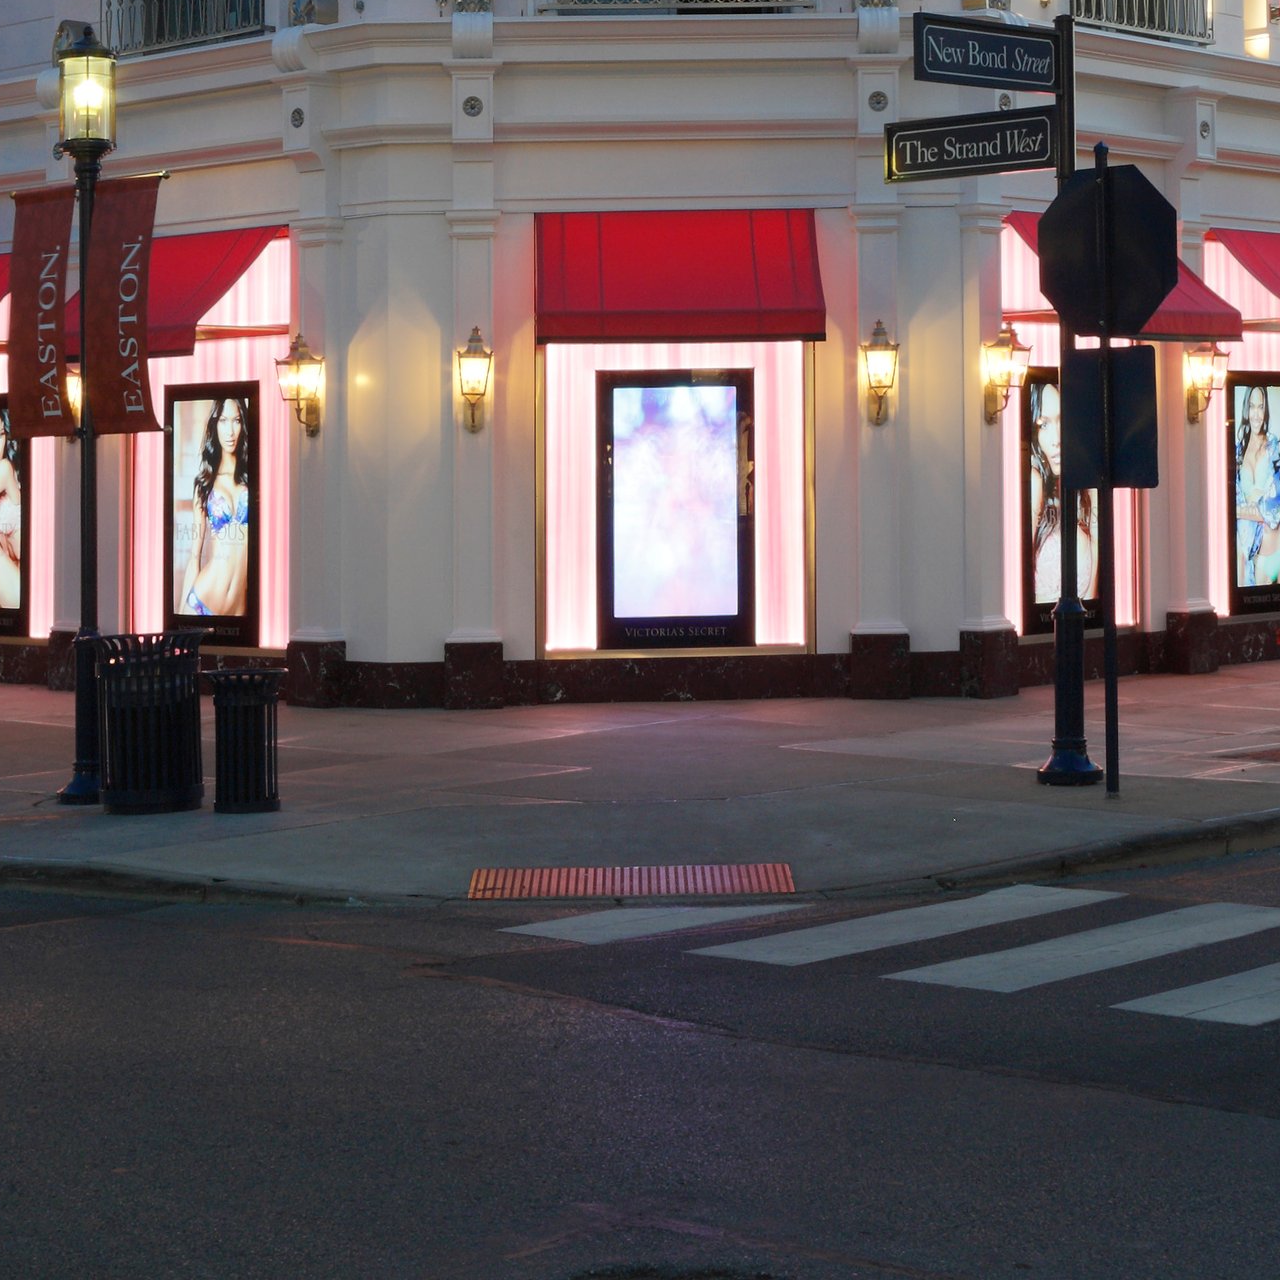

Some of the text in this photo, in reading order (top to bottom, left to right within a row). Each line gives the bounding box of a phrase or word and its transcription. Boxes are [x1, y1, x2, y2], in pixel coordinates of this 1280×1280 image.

[927, 35, 1051, 74] New Bond Street
[898, 128, 1044, 165] The Strand West
[624, 625, 728, 638] VICTORIA'S SECRET
